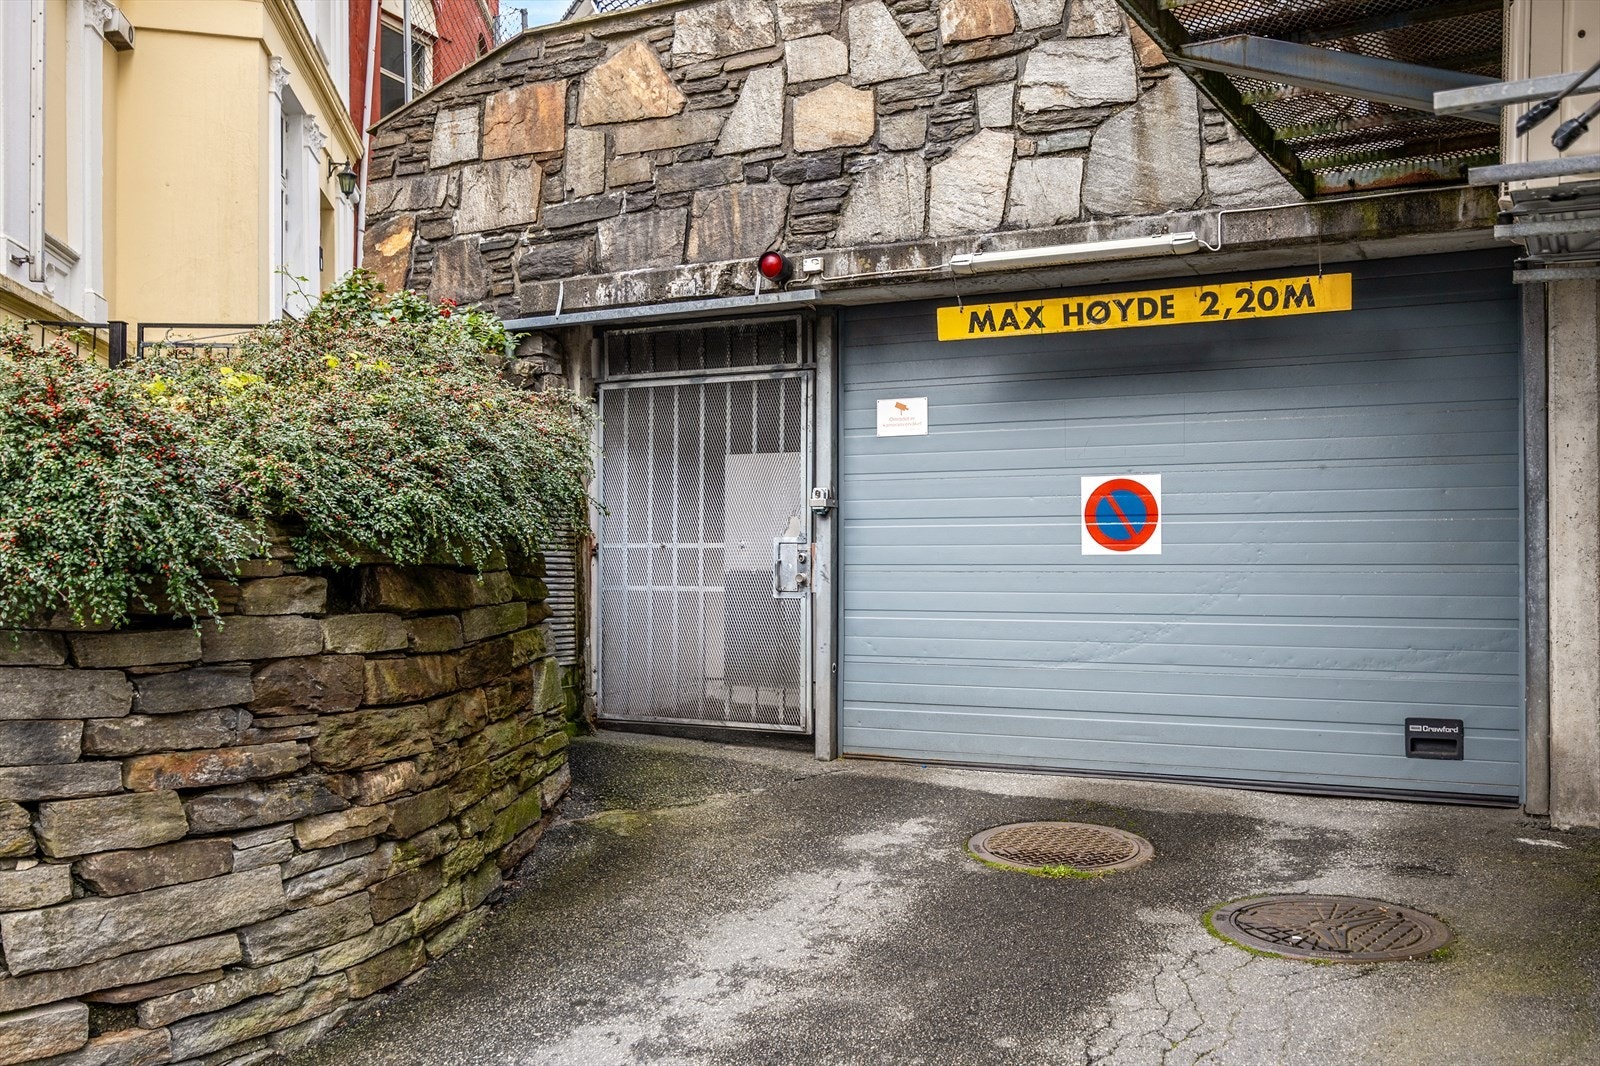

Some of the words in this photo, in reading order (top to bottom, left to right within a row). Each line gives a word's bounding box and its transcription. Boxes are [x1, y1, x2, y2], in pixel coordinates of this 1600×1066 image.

[968, 305, 1046, 334] MAX
[1063, 295, 1175, 326] HØYDE
[1200, 283, 1316, 320] 2,20M
[1422, 725, 1459, 733] Crawford
